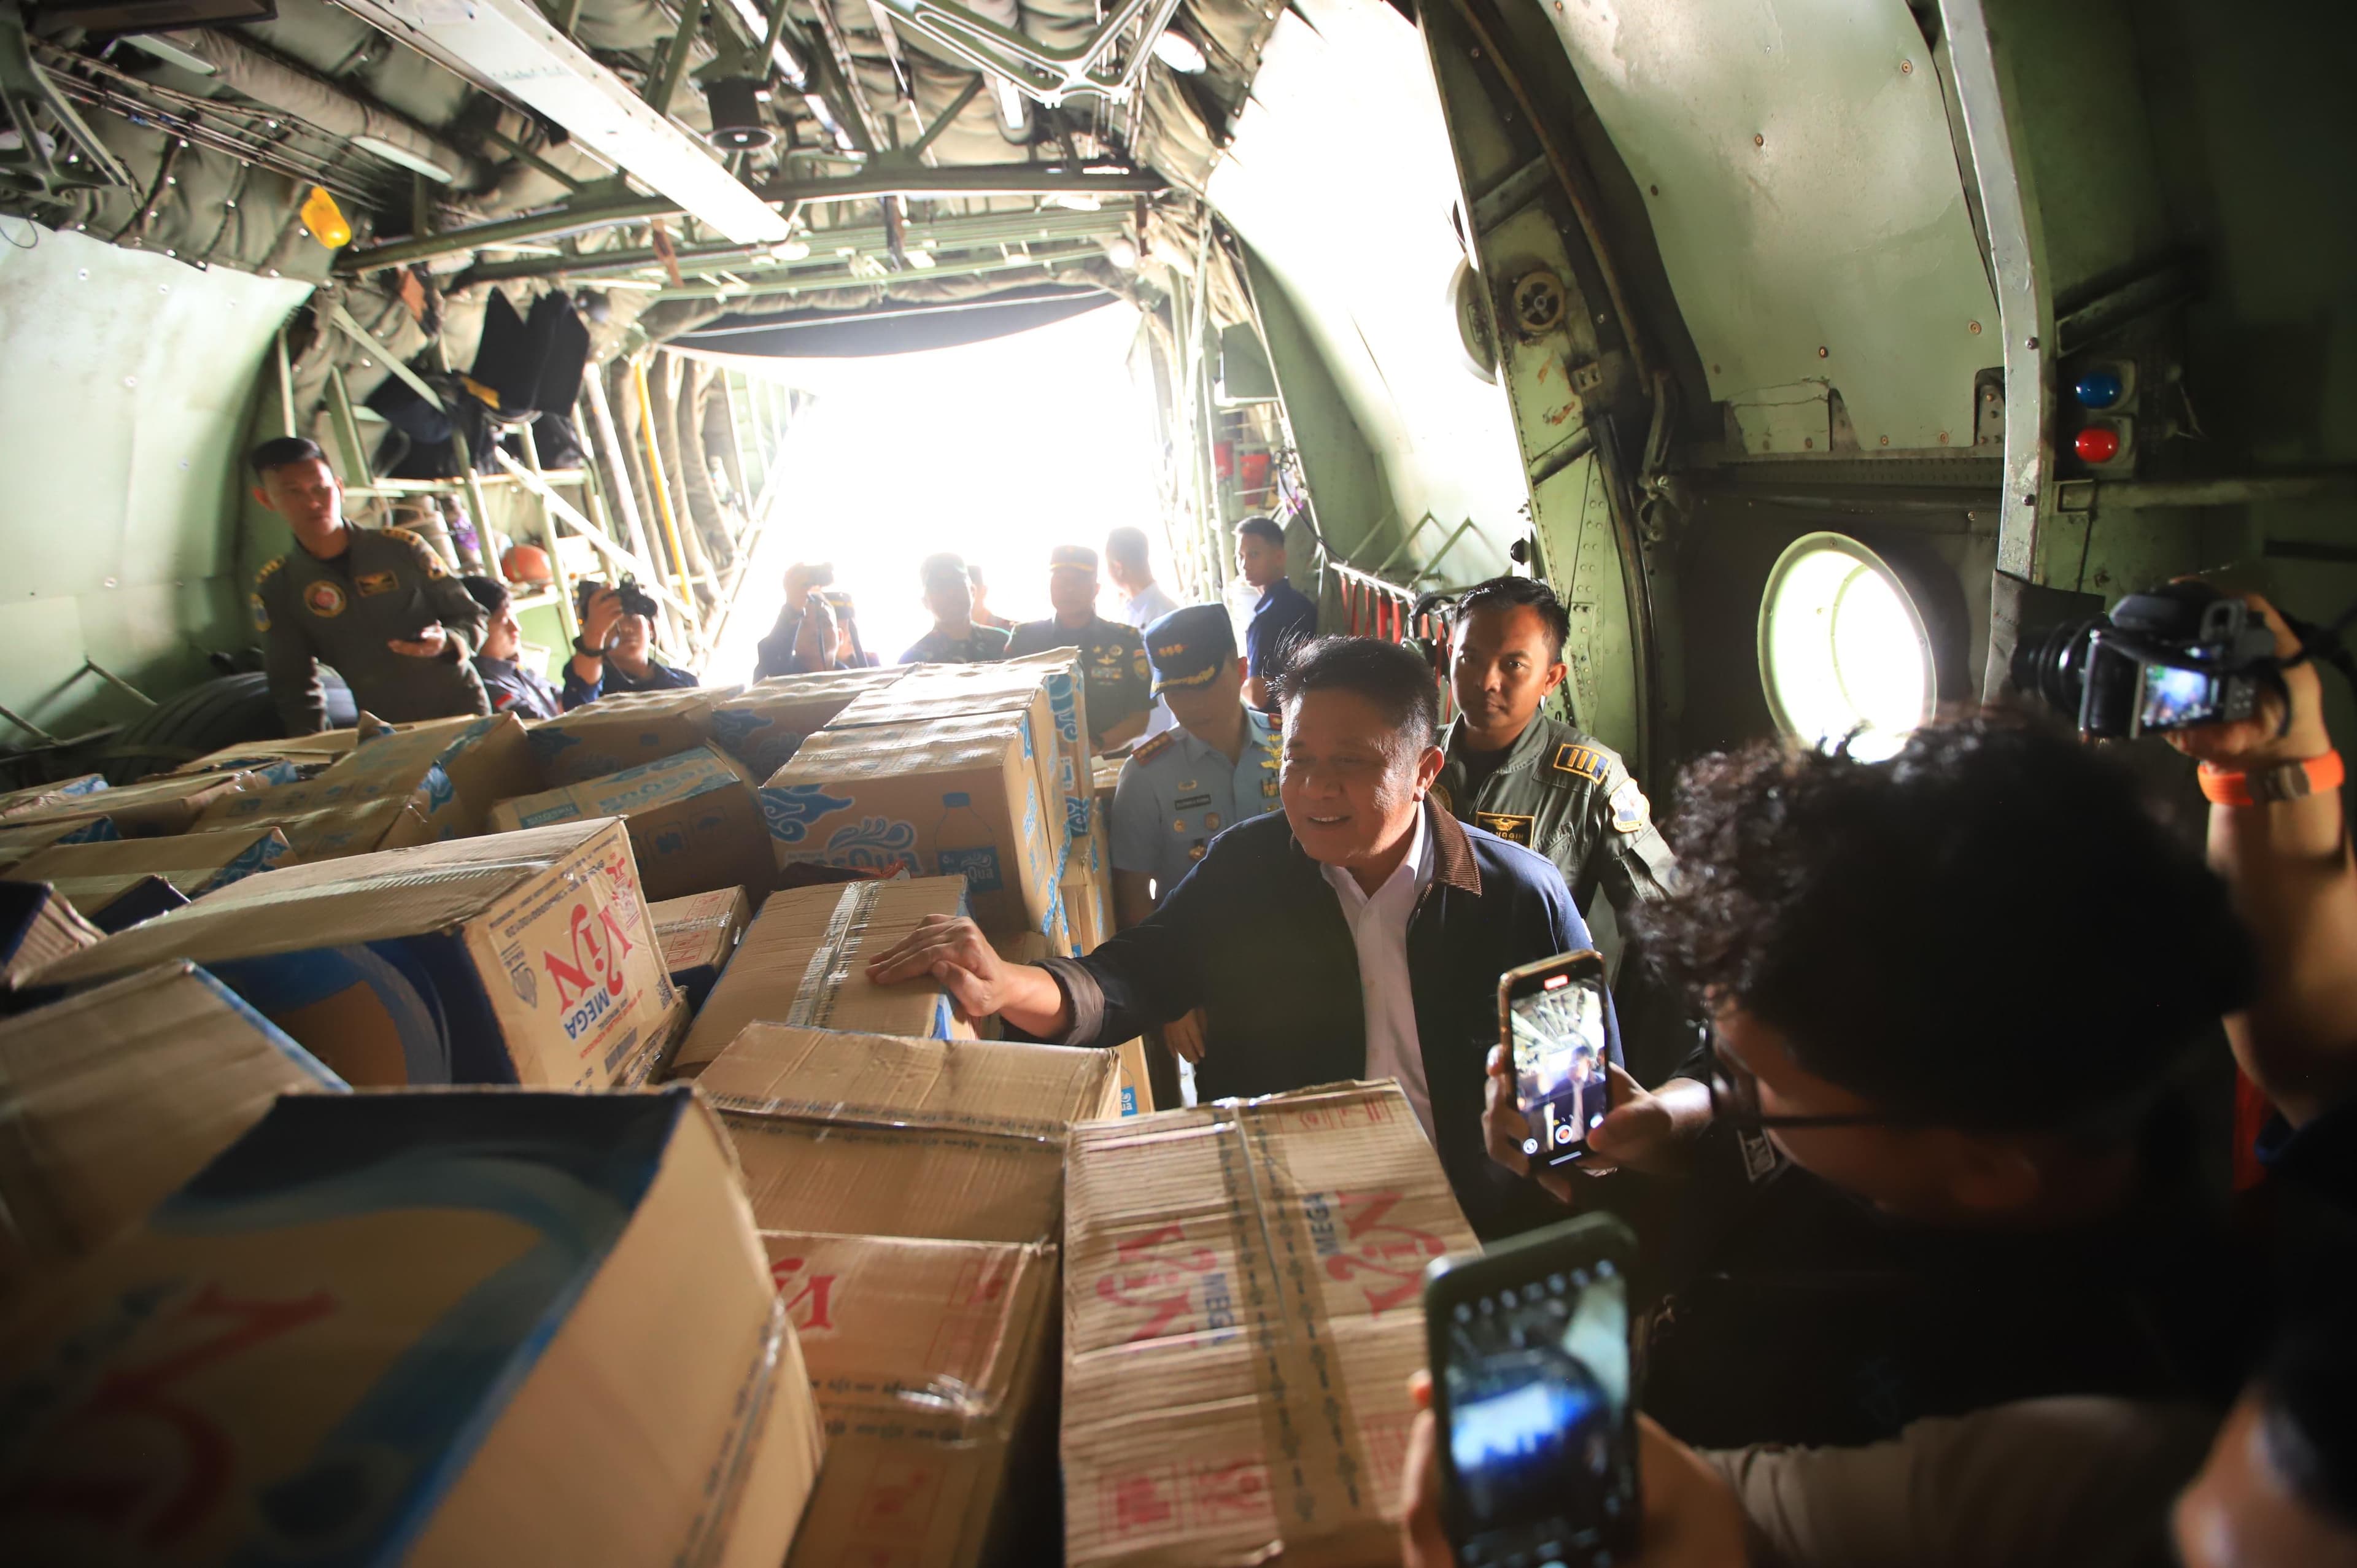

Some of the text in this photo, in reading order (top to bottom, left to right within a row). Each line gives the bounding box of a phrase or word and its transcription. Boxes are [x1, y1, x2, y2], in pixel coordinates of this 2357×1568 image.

[564, 987, 611, 1041] MEGA
[1301, 1191, 1341, 1256] MEGA
[1201, 1272, 1236, 1346] MEGA
